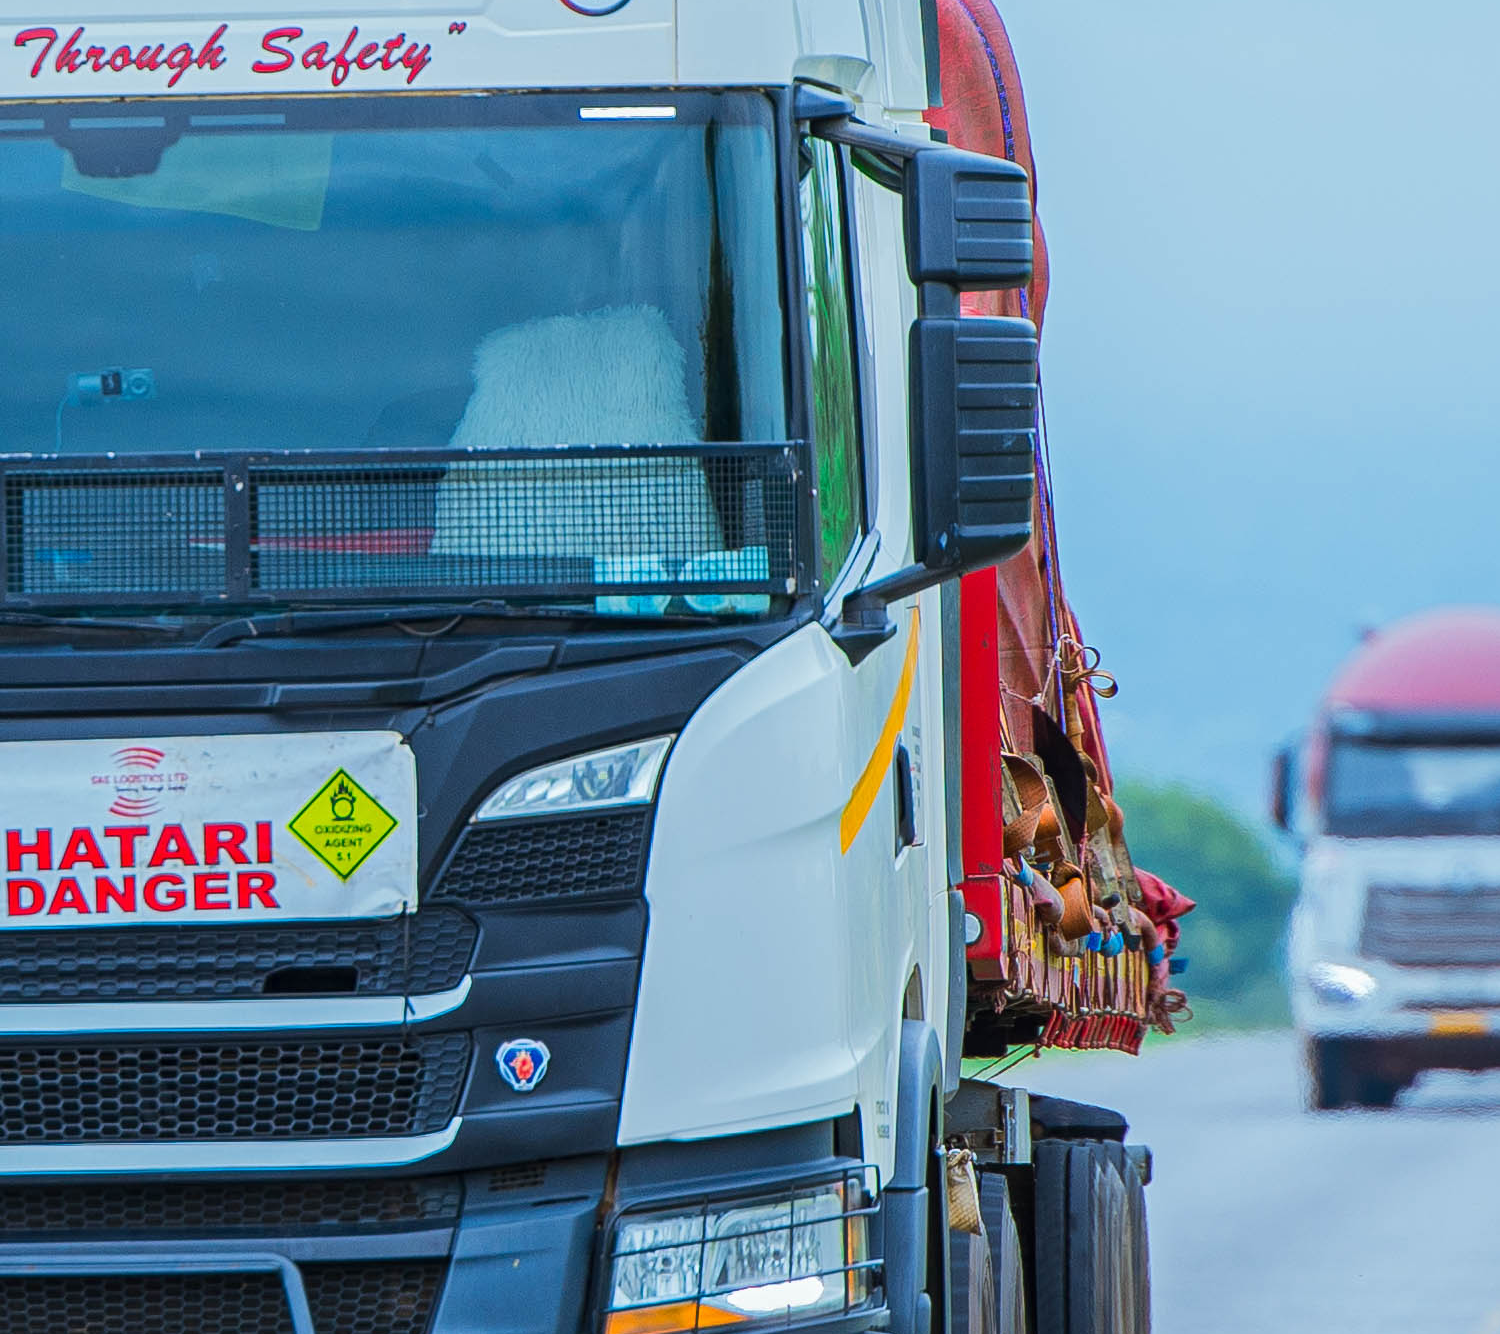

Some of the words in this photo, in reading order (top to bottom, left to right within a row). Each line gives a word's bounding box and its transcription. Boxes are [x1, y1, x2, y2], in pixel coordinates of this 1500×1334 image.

[14, 24, 229, 88] Through
[6, 821, 273, 872] HATARI
[324, 838, 363, 847] AGENT
[6, 871, 281, 916] DANGER
